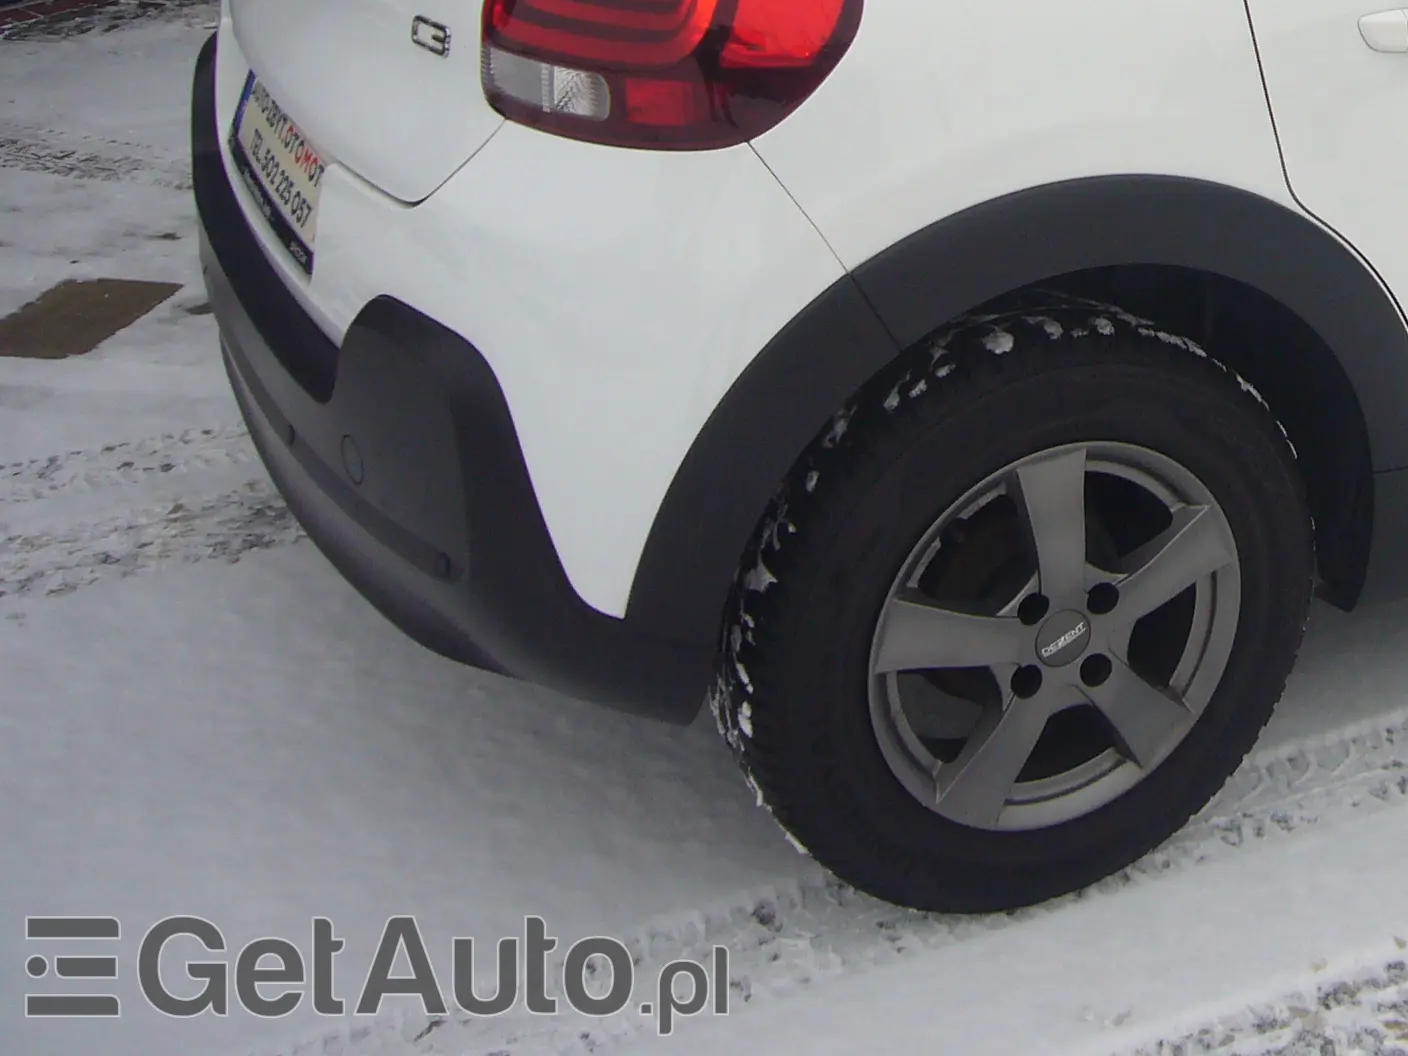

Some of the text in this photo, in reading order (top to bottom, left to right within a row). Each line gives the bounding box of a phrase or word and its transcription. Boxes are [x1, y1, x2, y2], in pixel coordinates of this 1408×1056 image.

[411, 15, 451, 59] C3
[291, 191, 312, 228] 057
[1041, 622, 1087, 657] DEZENT
